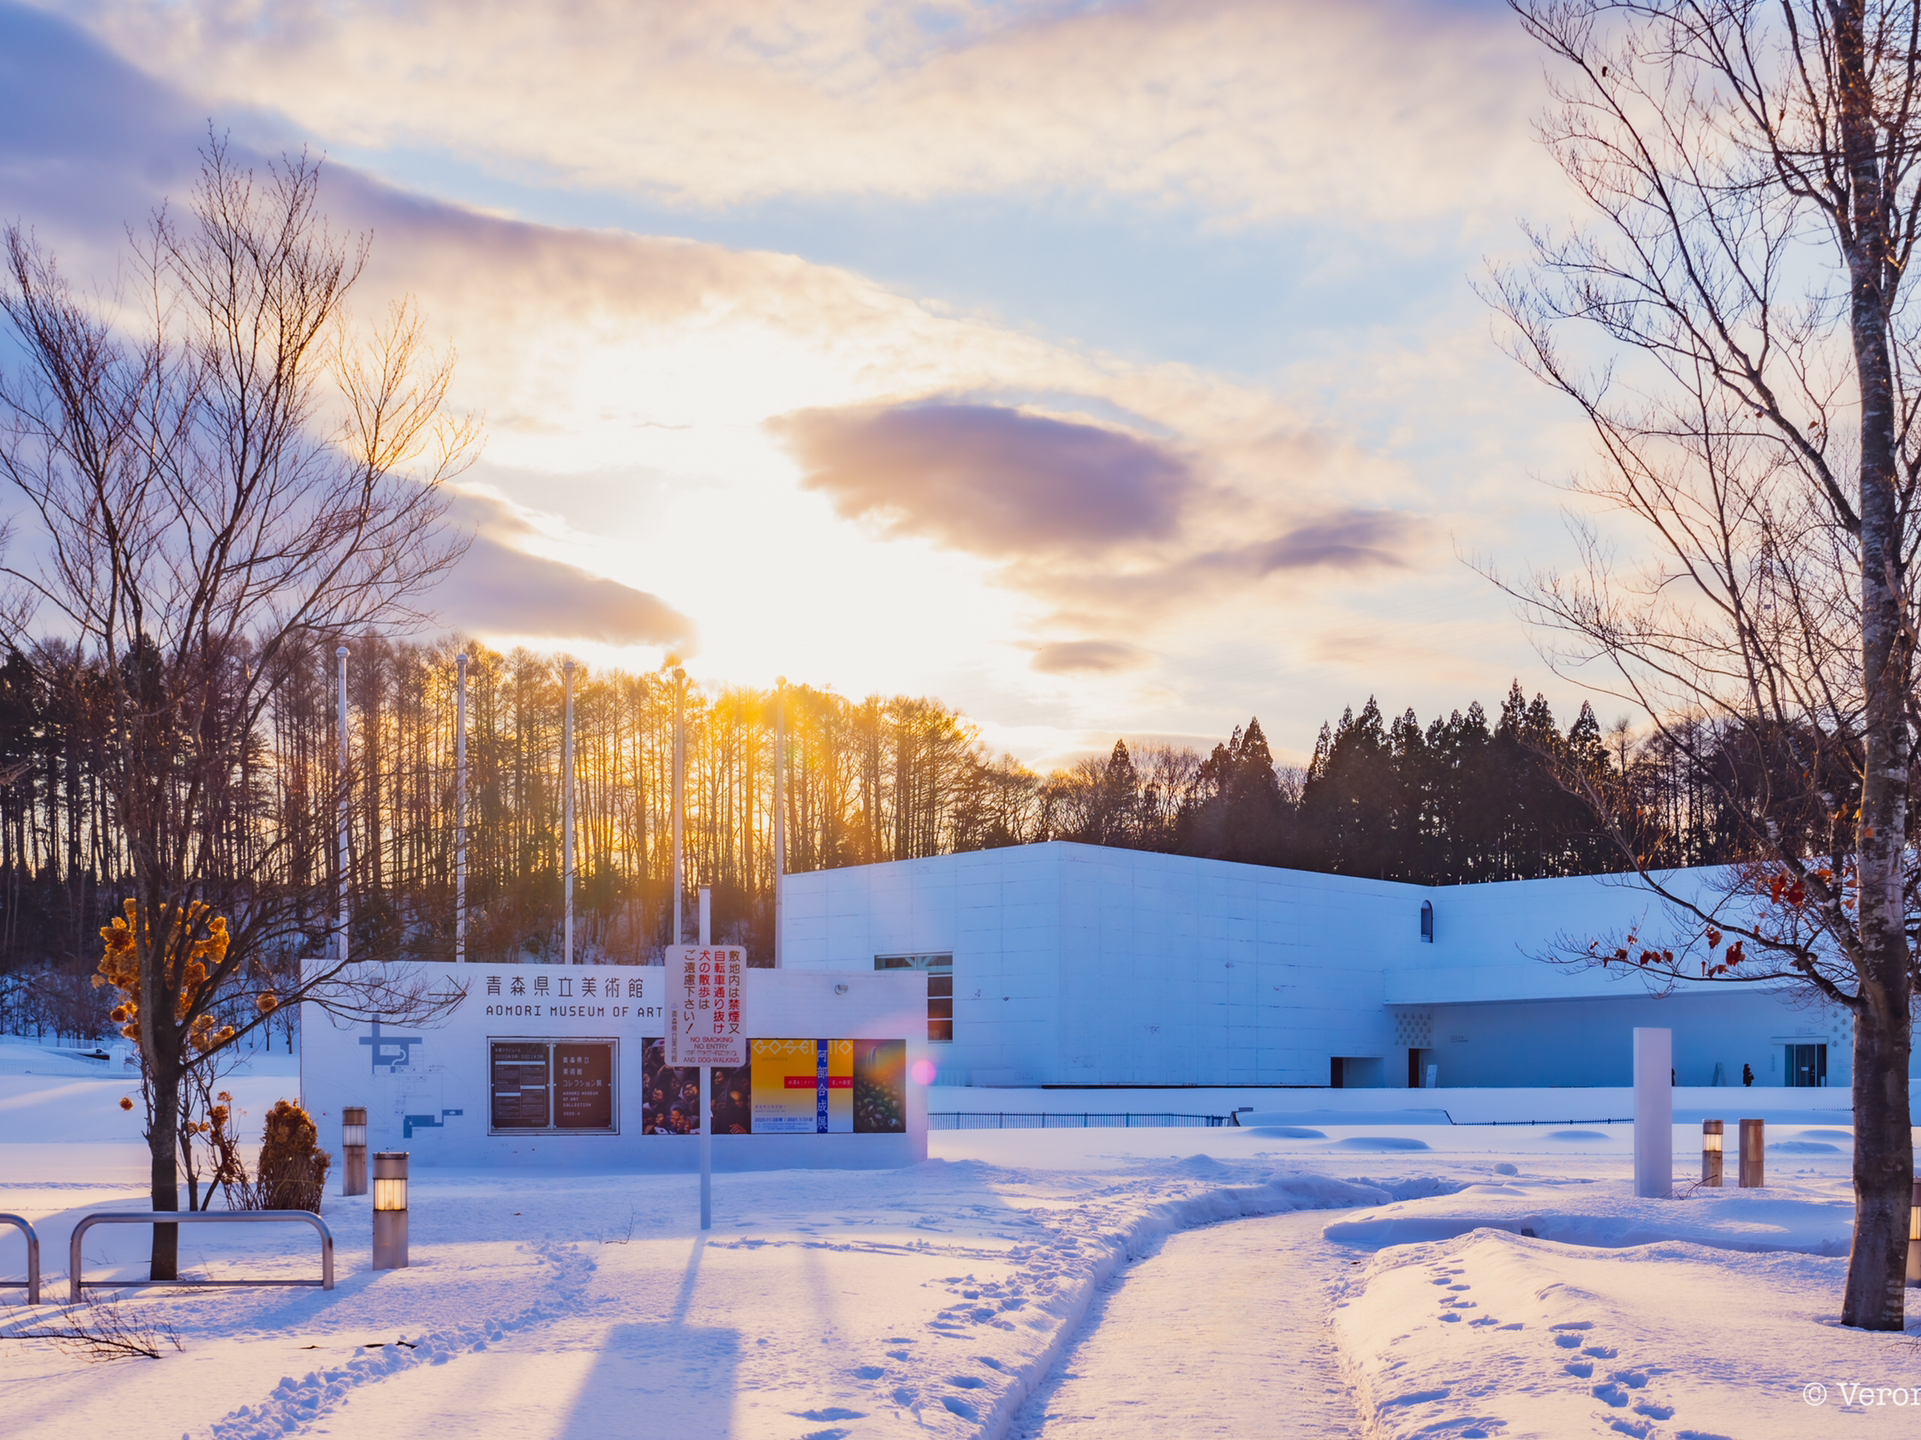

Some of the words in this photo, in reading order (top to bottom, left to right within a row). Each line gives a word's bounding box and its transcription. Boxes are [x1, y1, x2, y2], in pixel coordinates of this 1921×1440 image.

[486, 975, 644, 999] 青森県立美術館
[486, 1004, 542, 1017] AOMORI
[550, 1005, 605, 1017] MUSEUM
[612, 1006, 630, 1018] OF
[637, 1006, 663, 1018] ART
[698, 950, 711, 1010] 犬の散歩は
[713, 950, 725, 1034] 自転車通り抜け
[728, 950, 740, 1035] 敷地内は禁煙又
[816, 1049, 828, 1130] 阿部合成展
